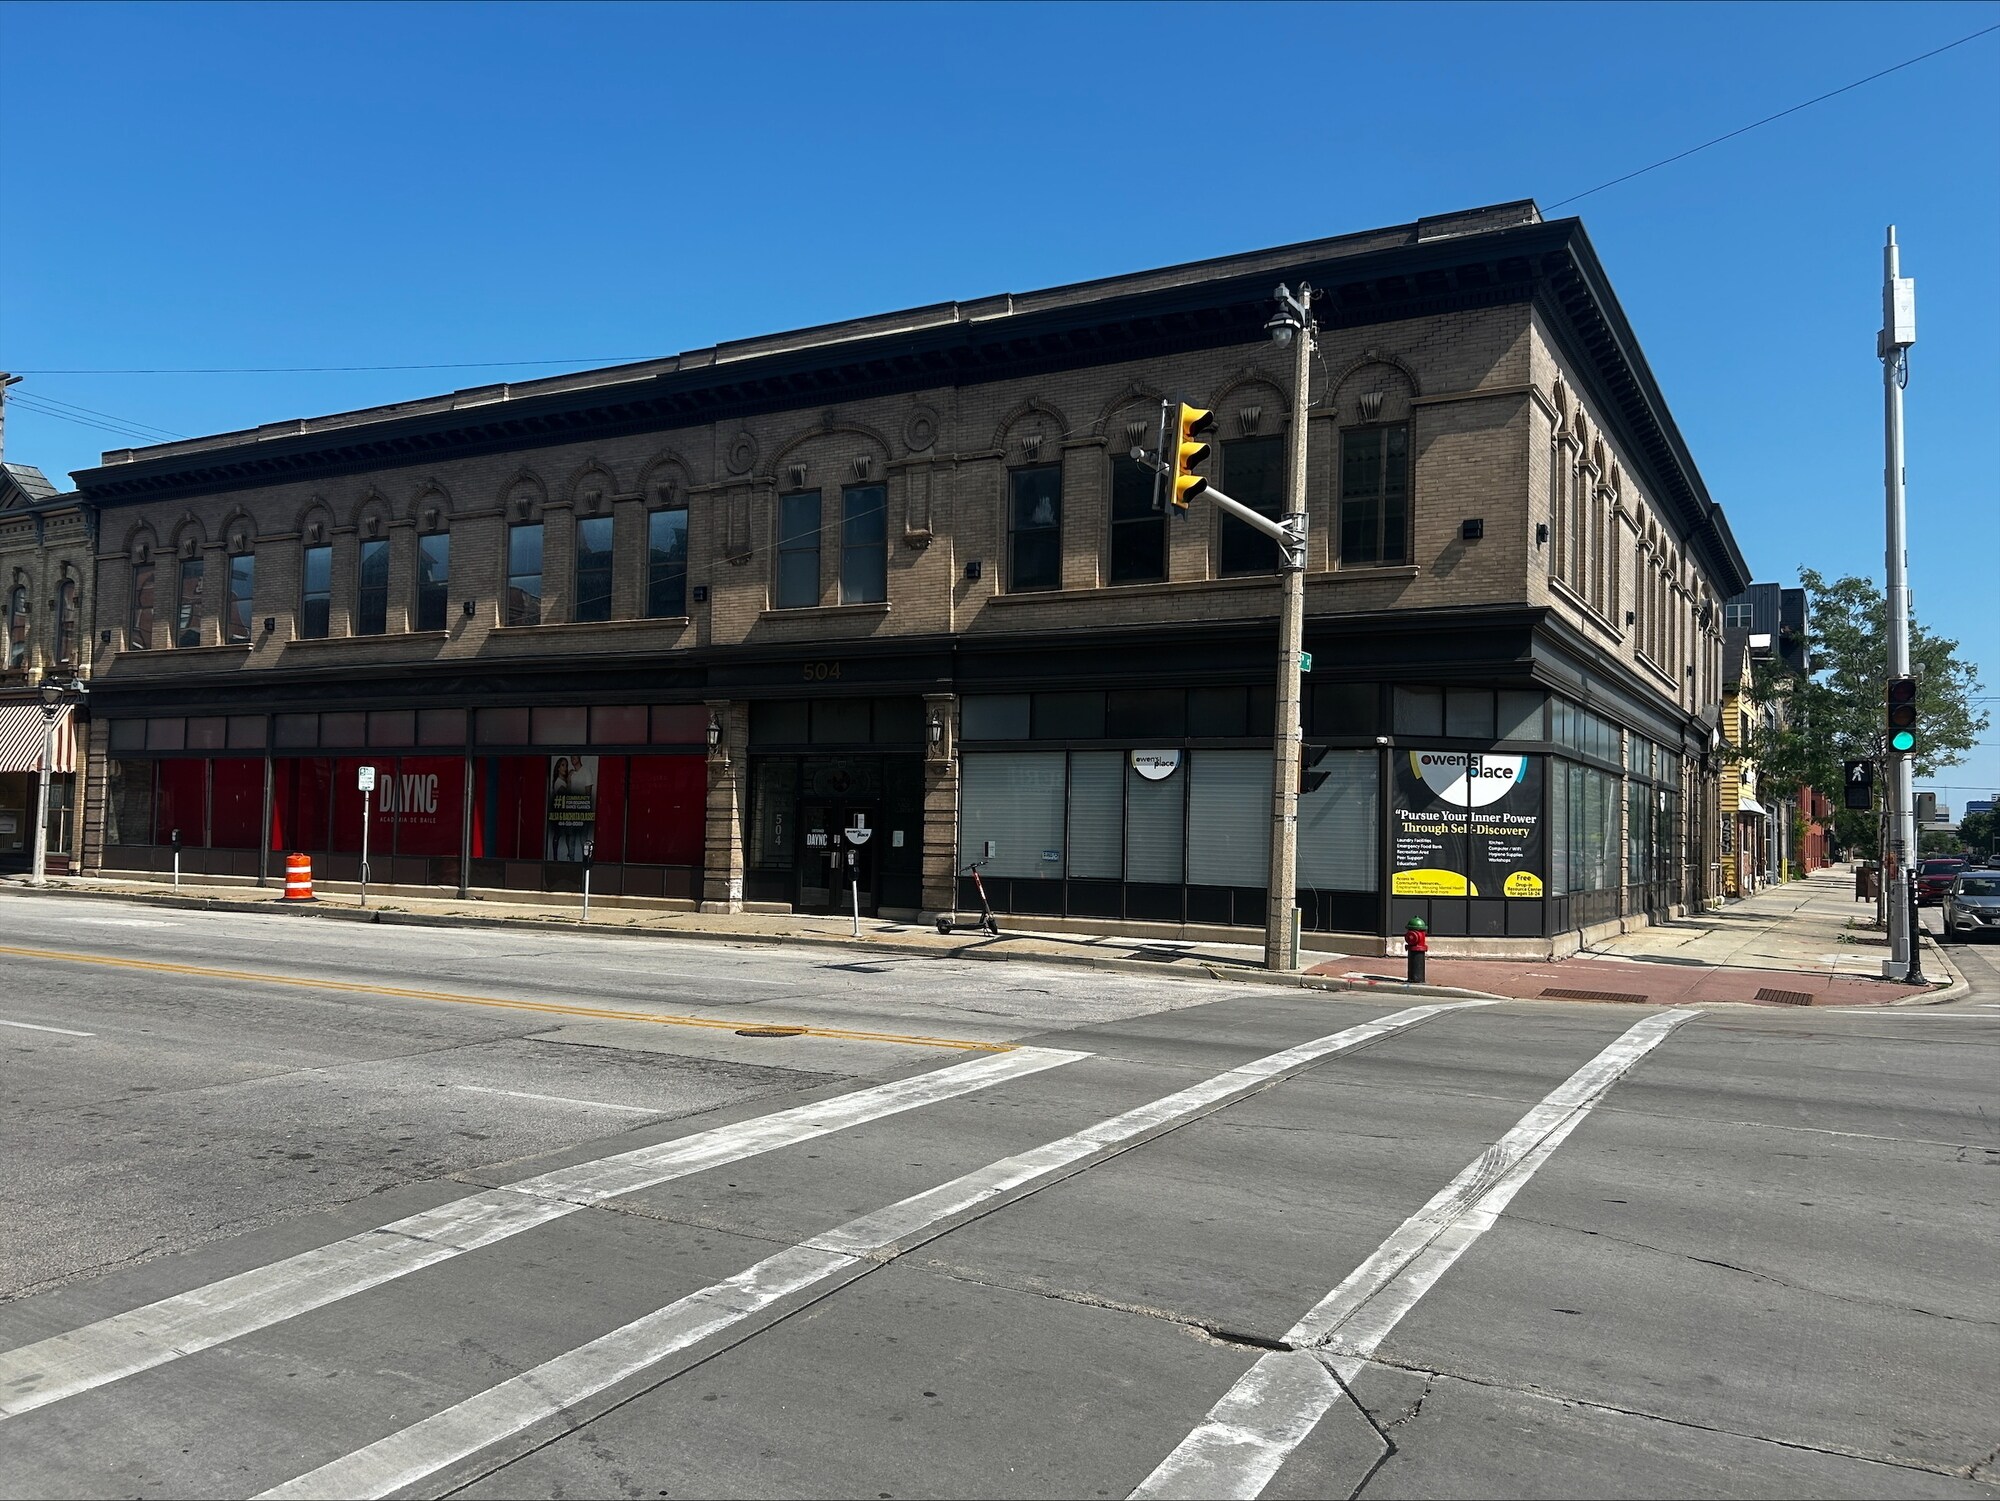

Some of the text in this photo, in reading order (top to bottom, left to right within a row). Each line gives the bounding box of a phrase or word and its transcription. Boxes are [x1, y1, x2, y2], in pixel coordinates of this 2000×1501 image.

[803, 662, 841, 680] 504
[1154, 757, 1174, 769] place
[1421, 754, 1478, 766] owen's
[1466, 755, 1513, 782] place
[380, 774, 438, 813] DAYNC
[554, 795, 566, 809] #1
[1441, 811, 1468, 821] Your
[1471, 812, 1501, 822] Inner
[1503, 813, 1537, 824] Power
[1402, 822, 1449, 836] Through
